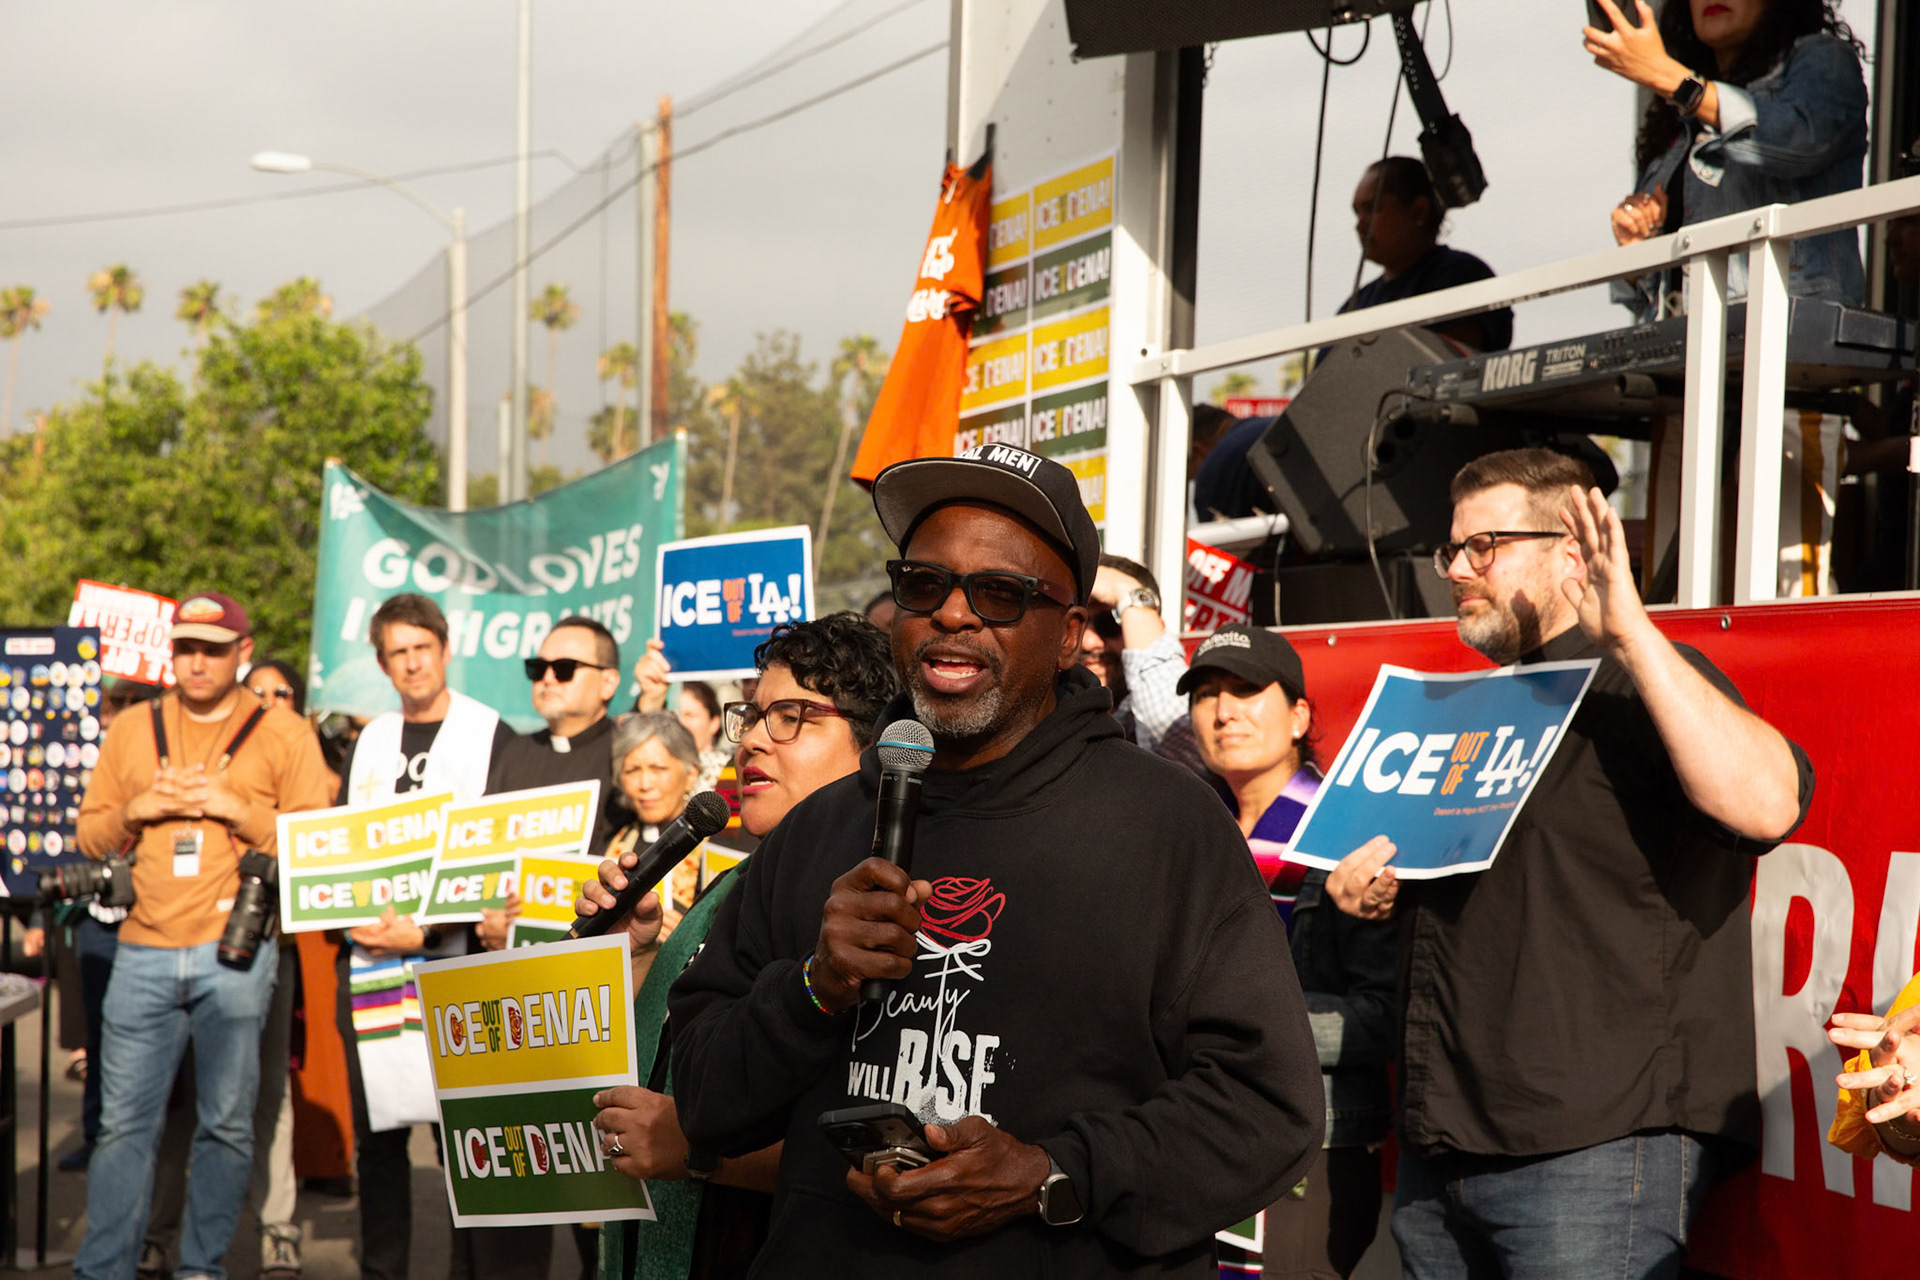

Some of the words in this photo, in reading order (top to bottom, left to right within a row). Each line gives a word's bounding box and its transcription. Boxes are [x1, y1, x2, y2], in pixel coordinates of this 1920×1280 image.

[1036, 197, 1060, 232] ICE
[1067, 176, 1112, 220] DENA!
[1035, 265, 1060, 301] ICE
[1066, 247, 1110, 291] DENA!
[984, 351, 1025, 389] DENA!
[1033, 341, 1059, 374] ICE
[1065, 327, 1107, 366] DENA!
[1482, 350, 1538, 392] KORG
[1545, 343, 1586, 365] TRITON
[1032, 410, 1055, 443] ICE
[1063, 397, 1106, 436] DENA!
[987, 446, 1034, 472] MEN
[362, 537, 498, 595] GOD
[495, 523, 643, 596] LOVES
[661, 579, 722, 628] ICE
[748, 573, 802, 625] LA!
[1336, 727, 1457, 796] ICE
[1450, 731, 1490, 763] OUT
[1475, 725, 1559, 799] LA!
[1440, 764, 1470, 795] OF
[296, 827, 350, 859] ICE
[366, 809, 441, 850] DENA
[448, 818, 494, 850] ICE
[506, 804, 585, 842] DENA!
[298, 882, 354, 910] ICE
[371, 869, 430, 906] DEN
[435, 874, 485, 904] ICE
[524, 873, 574, 907] ICE
[433, 1001, 487, 1057] ICE
[482, 1000, 500, 1027] OUT
[501, 984, 611, 1051] DENA!
[488, 1027, 500, 1052] OF
[847, 1061, 891, 1102] WILL
[453, 1127, 512, 1179] ICE
[504, 1125, 525, 1151] OUT
[522, 1121, 618, 1176] DENA
[512, 1152, 526, 1178] OF
